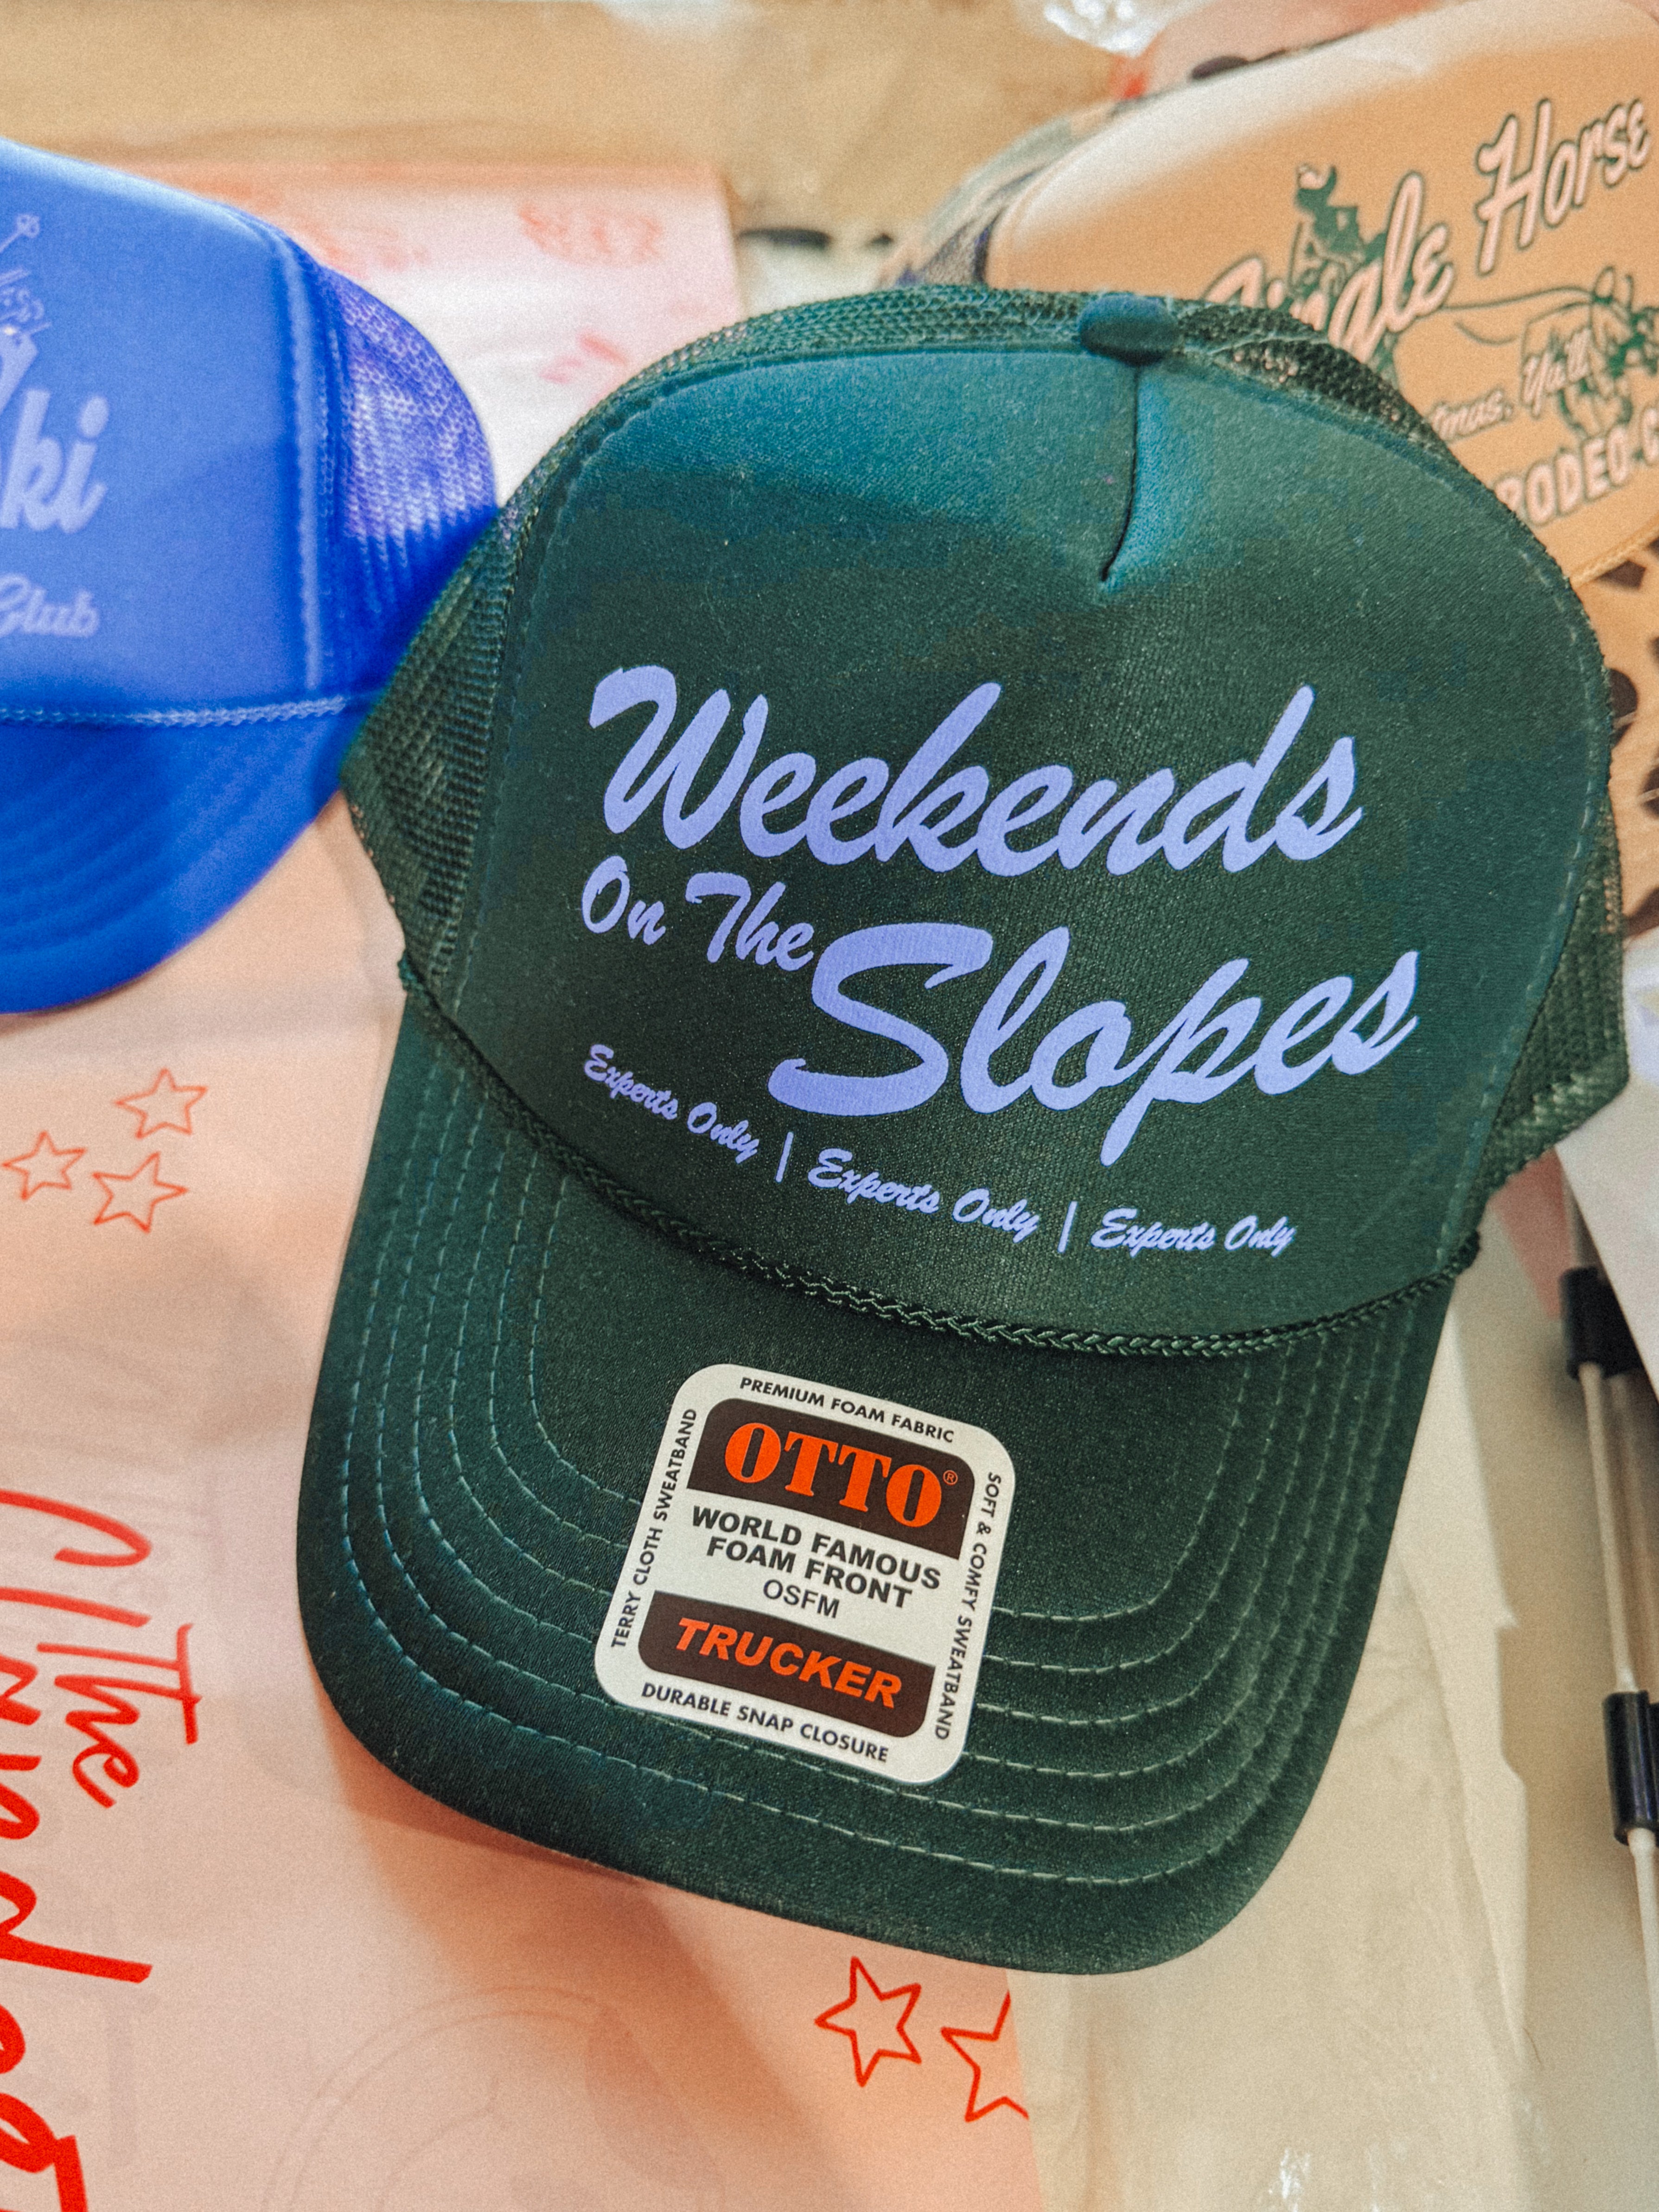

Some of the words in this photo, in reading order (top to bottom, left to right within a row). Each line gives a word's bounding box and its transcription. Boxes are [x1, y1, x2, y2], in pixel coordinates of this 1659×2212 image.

[1475, 98, 1651, 276] Horse
[0, 332, 109, 533] ki
[588, 664, 1363, 877] Weekends
[581, 855, 666, 945] On
[684, 871, 815, 972] The
[767, 922, 1419, 1167] Slopes
[584, 1044, 678, 1120] Experts
[687, 1102, 759, 1164] Only
[807, 1147, 940, 1214] Experts
[952, 1188, 1039, 1243] Only
[1090, 1207, 1216, 1258] Experts
[1224, 1215, 1297, 1258] Only
[740, 1377, 825, 1408] PREMIUM
[830, 1397, 885, 1423] FOAM
[891, 1414, 954, 1443] FABRIC
[610, 1591, 641, 1648] TERRY
[632, 1527, 664, 1586] CLOTH
[653, 1409, 697, 1522] SWEATBAND
[976, 1521, 992, 1535] &
[981, 1472, 1002, 1518] SOFT
[692, 1505, 802, 1546] WORLD
[810, 1532, 941, 1590] FAMOUS
[706, 1536, 797, 1574] FOAM
[804, 1558, 913, 1608] FRONT
[962, 1543, 987, 1612] COMFY
[763, 1579, 840, 1619] OSFM
[676, 1618, 902, 1708] TRUCKER
[935, 1615, 973, 1740] SWEATBAND
[37, 1625, 201, 1809] The
[641, 1682, 732, 1717] DURABLE
[737, 1705, 794, 1732] SNAP
[800, 1723, 889, 1763] CLOSURE
